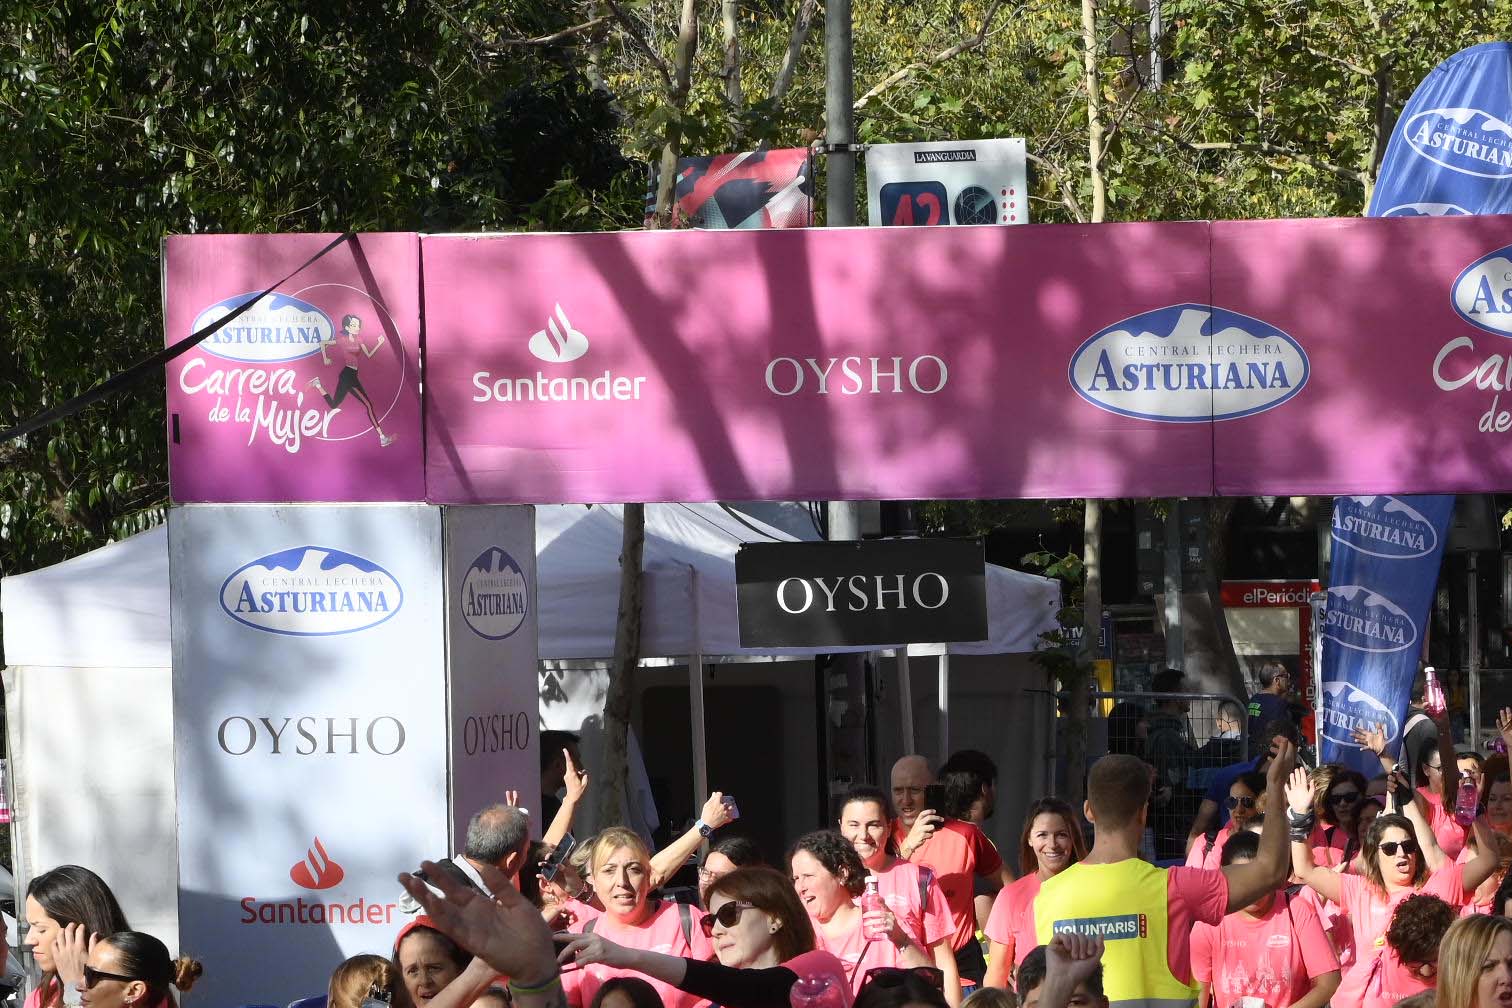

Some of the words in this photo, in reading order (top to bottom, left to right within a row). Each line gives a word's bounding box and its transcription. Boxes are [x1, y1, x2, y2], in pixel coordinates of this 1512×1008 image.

[926, 151, 975, 161] VANGUARDIA
[1124, 344, 1199, 357] CENTRAL
[1207, 343, 1283, 356] LECHERA
[179, 357, 297, 395] Carrera
[472, 370, 646, 402] Santander
[765, 354, 949, 397] OYSHO
[1087, 348, 1292, 392] ASTURIANA
[208, 397, 230, 423] de
[235, 396, 250, 422] la
[248, 392, 342, 453] Mujer
[1478, 394, 1512, 433] de
[1331, 504, 1426, 551] ASTURIANA
[234, 580, 389, 614] ASTURIANA
[263, 577, 319, 587] CENTRAL
[326, 576, 384, 586] LECHERA
[466, 582, 525, 617] ASTURIANA
[776, 572, 949, 615] OYSHO
[1243, 588, 1313, 604] elPeriódi
[1324, 609, 1405, 644] STURIANA
[217, 715, 407, 756] OYSHO
[463, 711, 530, 757] OYSHO
[240, 896, 397, 924] Santander
